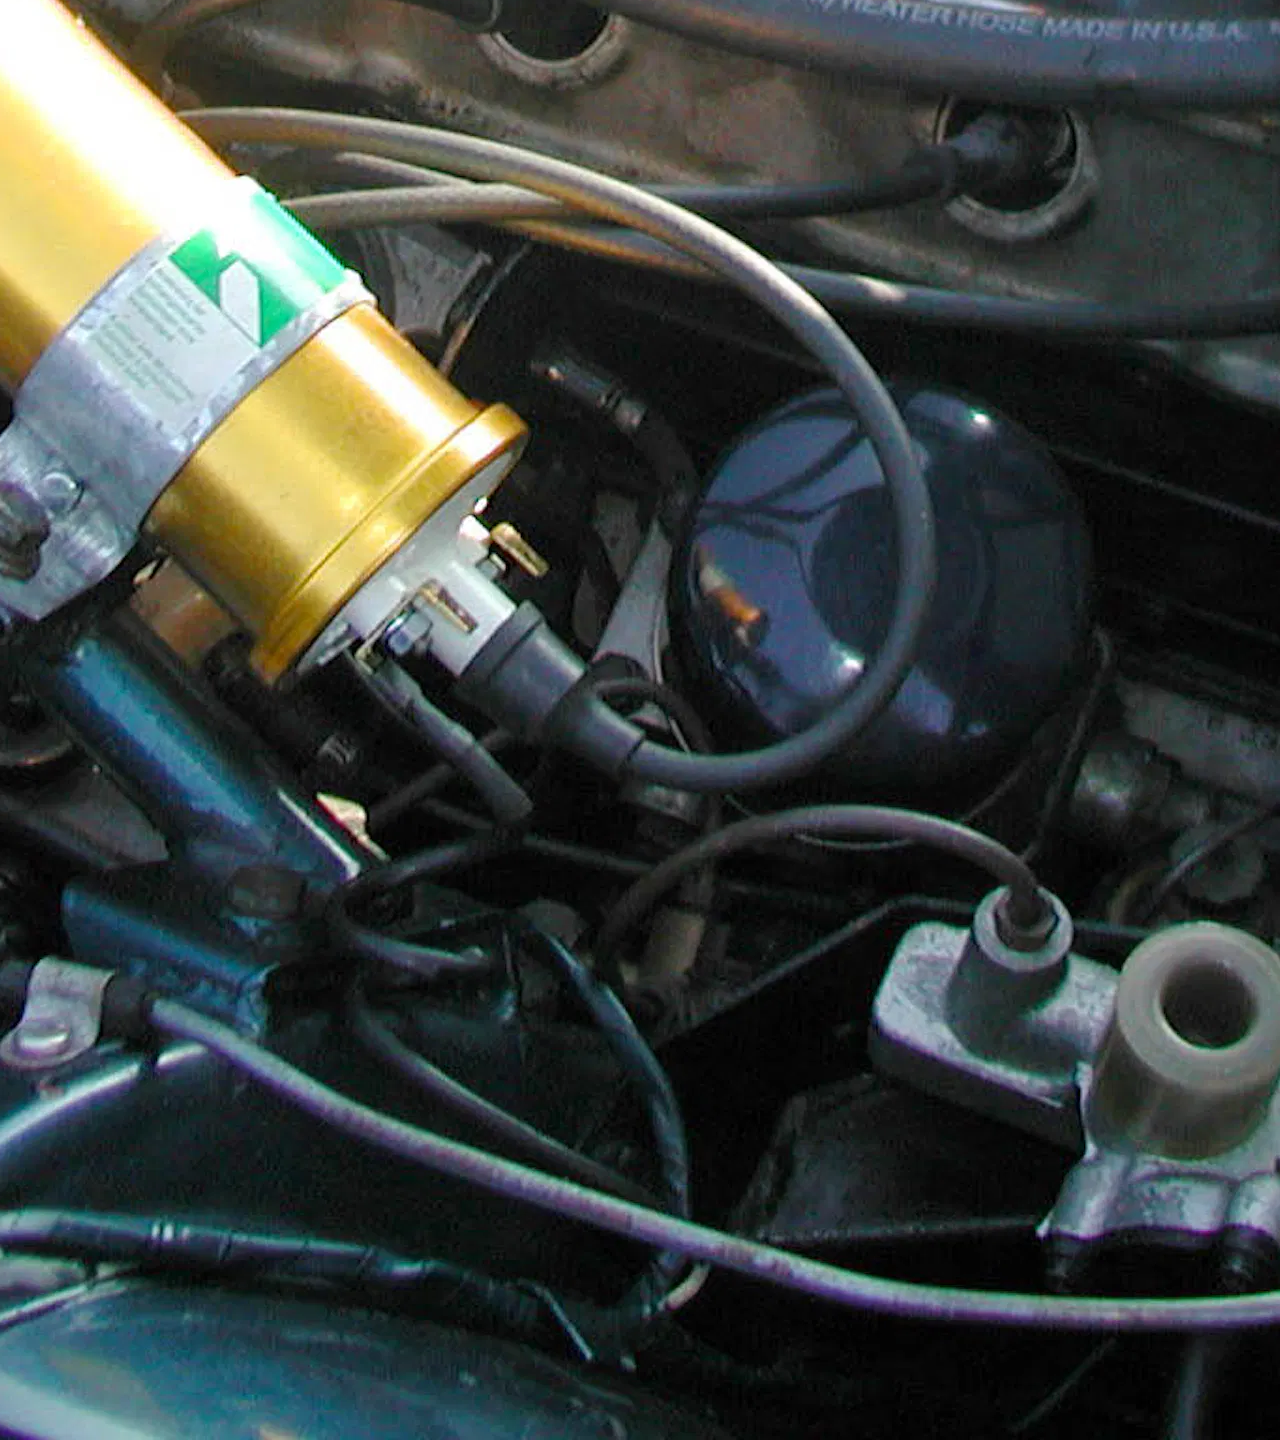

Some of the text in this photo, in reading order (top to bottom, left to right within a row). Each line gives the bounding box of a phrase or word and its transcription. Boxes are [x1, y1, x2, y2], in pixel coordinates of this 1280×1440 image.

[956, 10, 1034, 35] HOSE
[1042, 17, 1123, 41] MADE
[1130, 19, 1163, 42] IN
